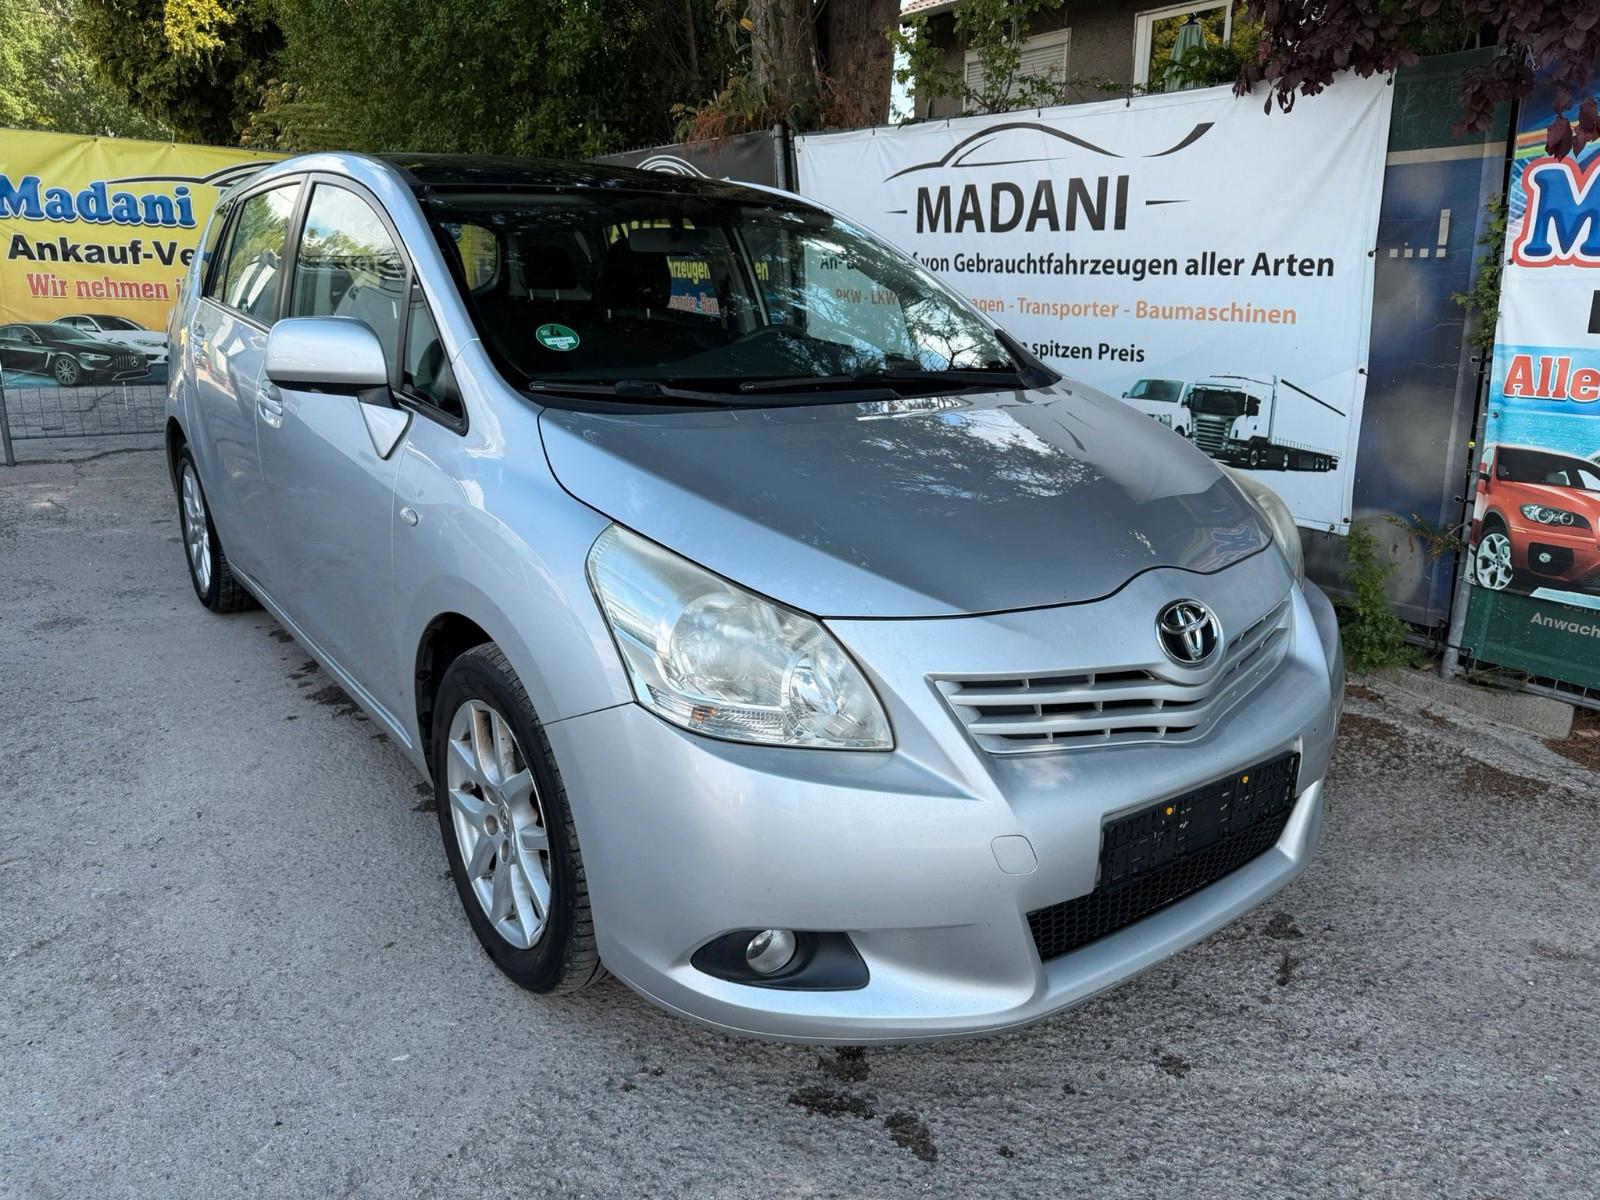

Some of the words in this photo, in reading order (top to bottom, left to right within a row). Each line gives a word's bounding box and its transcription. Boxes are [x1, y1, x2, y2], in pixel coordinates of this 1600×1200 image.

[0, 174, 196, 228] Madani
[916, 175, 1130, 233] MADANI
[921, 257, 949, 272] von
[954, 252, 1178, 281] Gebrauchtfahrzeugen
[1185, 251, 1245, 276] aller
[1251, 252, 1334, 277] Arten
[26, 273, 68, 297] Wir
[76, 277, 169, 299] nehmen
[835, 288, 860, 304] PKW
[969, 298, 1004, 313] agen
[1017, 297, 1119, 320] Transporter
[1135, 301, 1297, 324] Baumaschinen
[1032, 340, 1093, 360] spitzen
[1098, 343, 1145, 362] Preis
[1503, 354, 1600, 403] Alle
